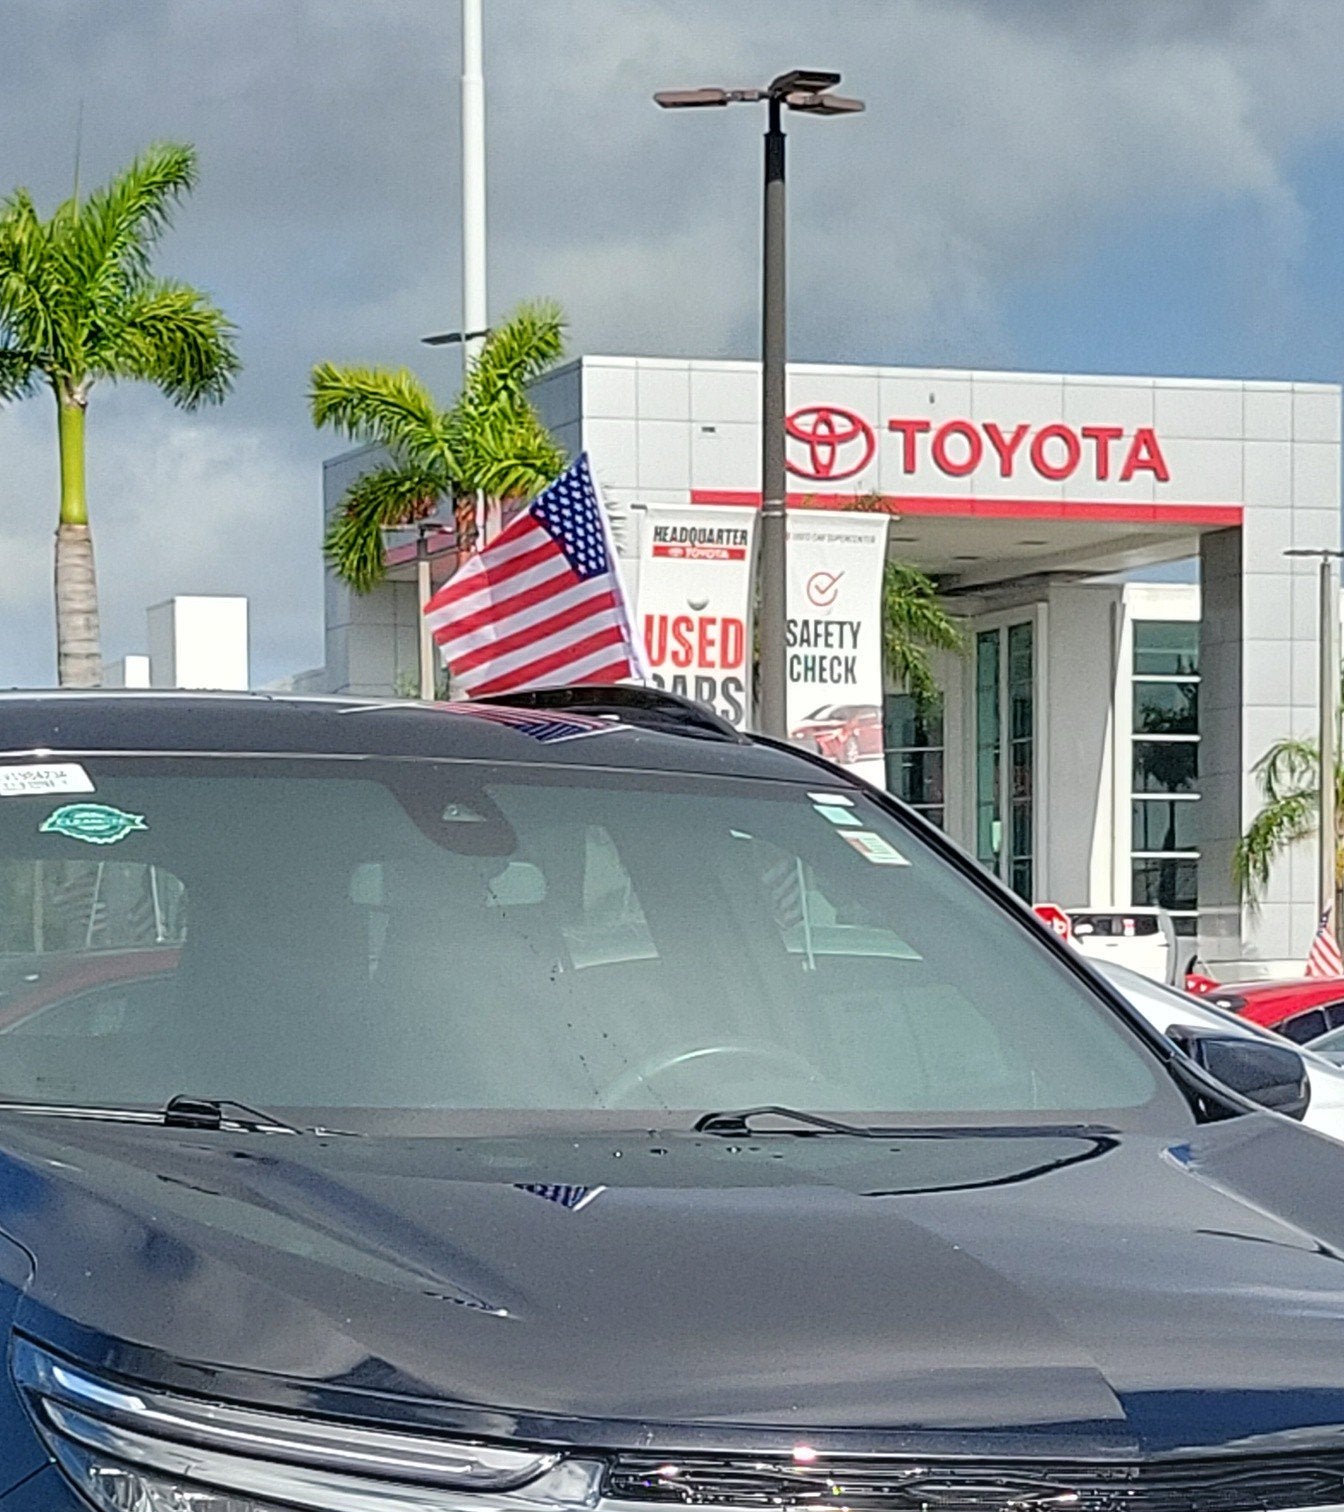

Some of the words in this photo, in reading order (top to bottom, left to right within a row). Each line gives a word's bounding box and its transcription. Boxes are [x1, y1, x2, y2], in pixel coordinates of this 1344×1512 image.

[888, 419, 1171, 482] TOYOTA
[654, 525, 748, 546] HEADQUARTER
[686, 547, 730, 559] TOYOTA
[644, 614, 744, 669] USED
[786, 618, 862, 650] SAFETY
[789, 654, 858, 684] CHECK
